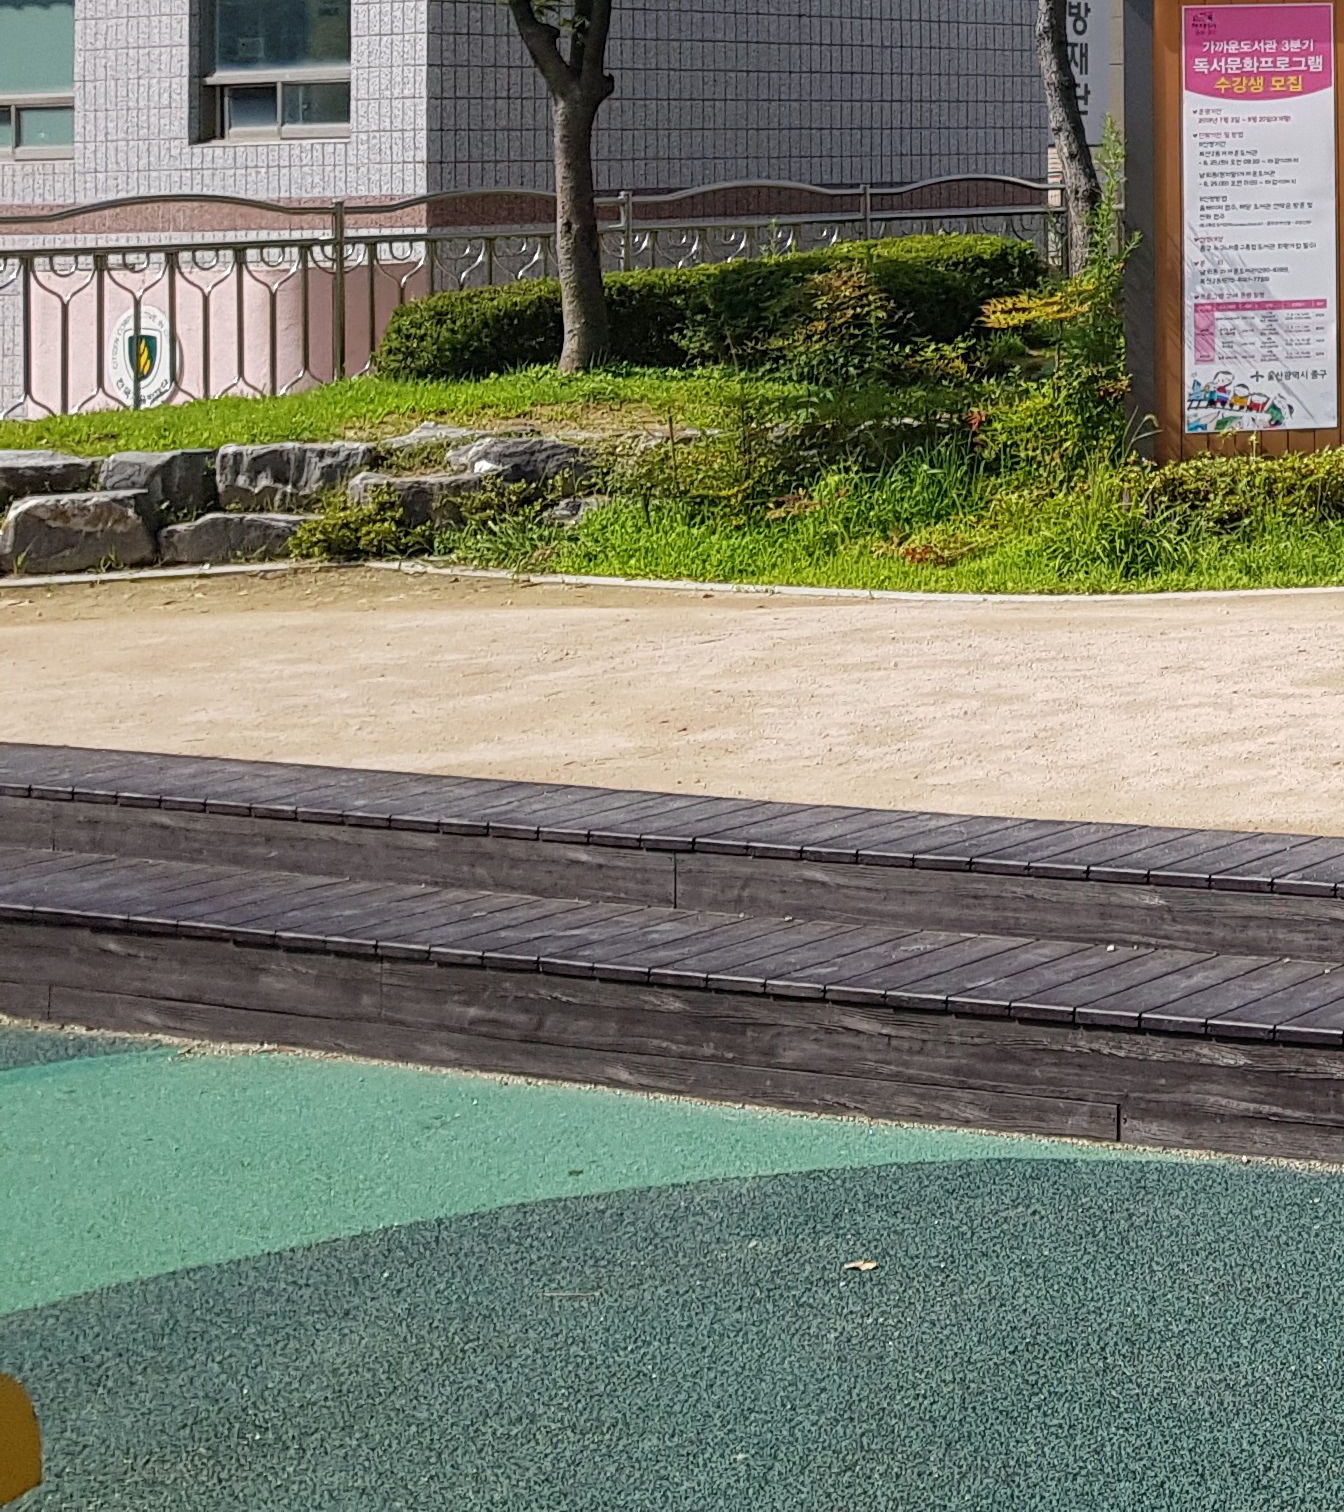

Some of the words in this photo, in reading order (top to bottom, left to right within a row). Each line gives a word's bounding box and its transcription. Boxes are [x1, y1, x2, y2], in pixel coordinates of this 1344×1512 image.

[1202, 39, 1277, 54] 가까운도서관
[1281, 39, 1314, 52] 3분기
[1193, 55, 1323, 74] 독서문화프로그램
[1214, 76, 1264, 93] 수강생
[1270, 75, 1303, 92] 모집
[1267, 370, 1309, 382] 울산광역시
